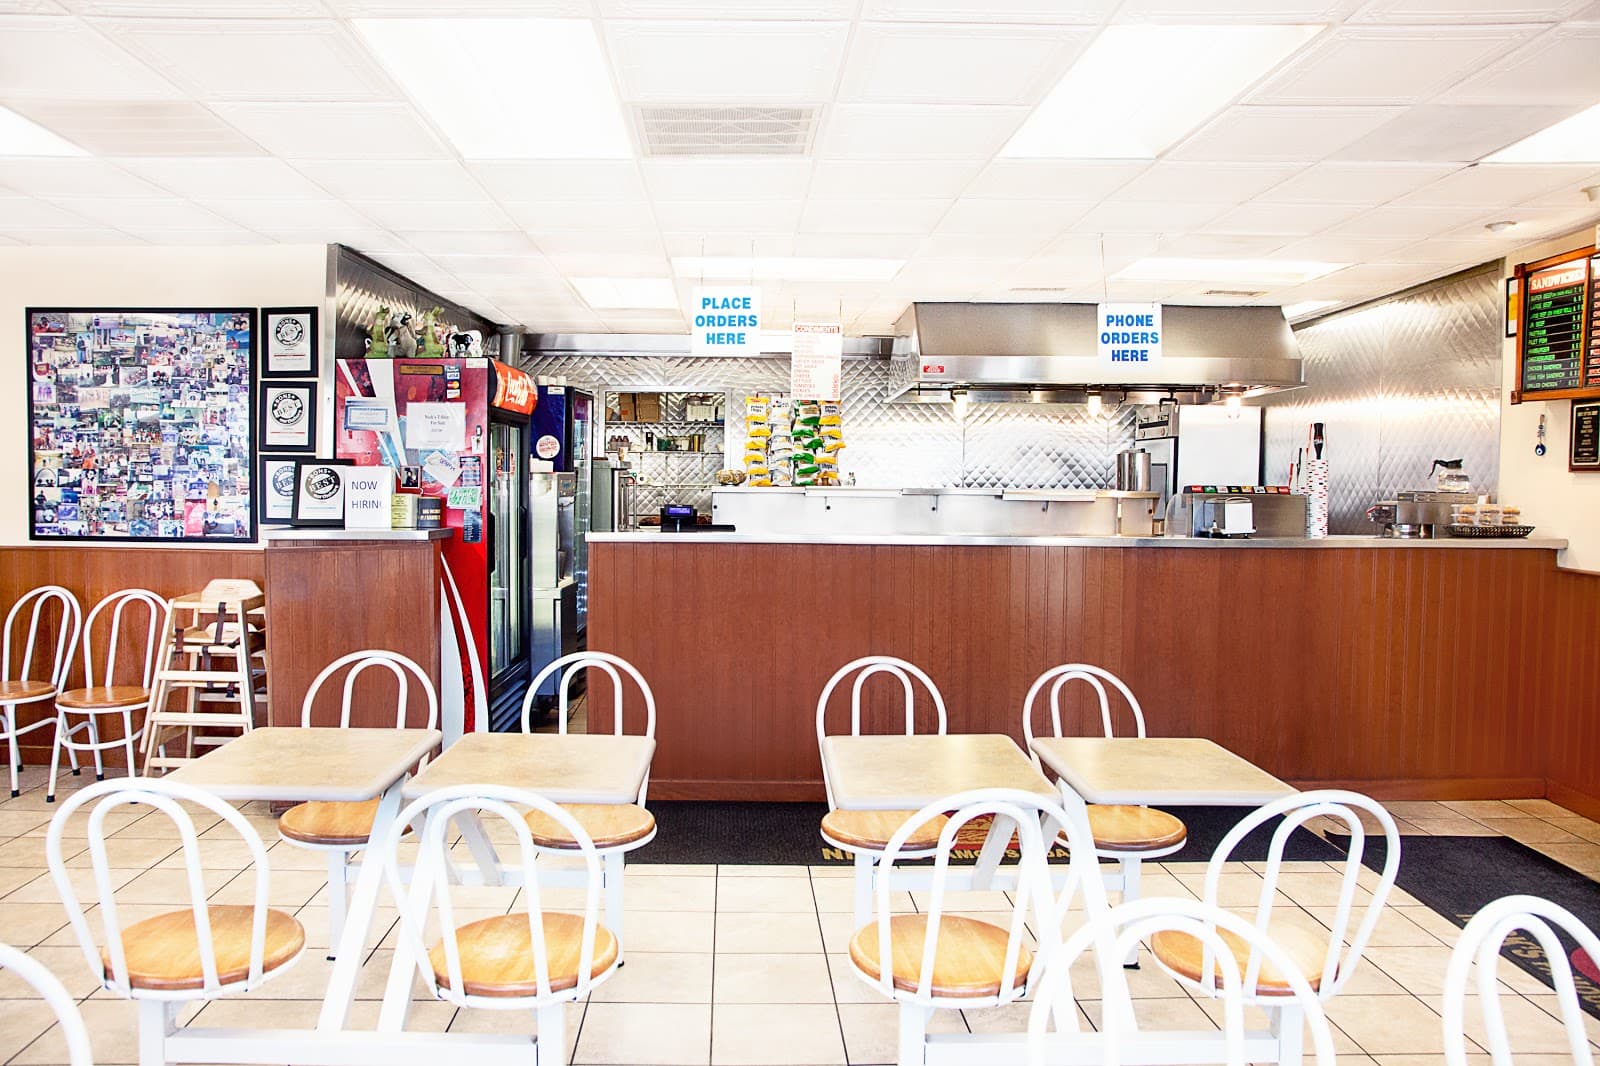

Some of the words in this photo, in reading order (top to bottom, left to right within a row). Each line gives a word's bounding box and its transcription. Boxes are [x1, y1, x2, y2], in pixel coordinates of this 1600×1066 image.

[702, 297, 751, 310] PLACE
[695, 314, 758, 327] ORDERS
[1106, 314, 1153, 327] PHONE
[706, 332, 746, 345] HERE
[1101, 332, 1159, 345] ORDERS
[1111, 349, 1148, 362] HERE
[352, 480, 377, 490] NOW
